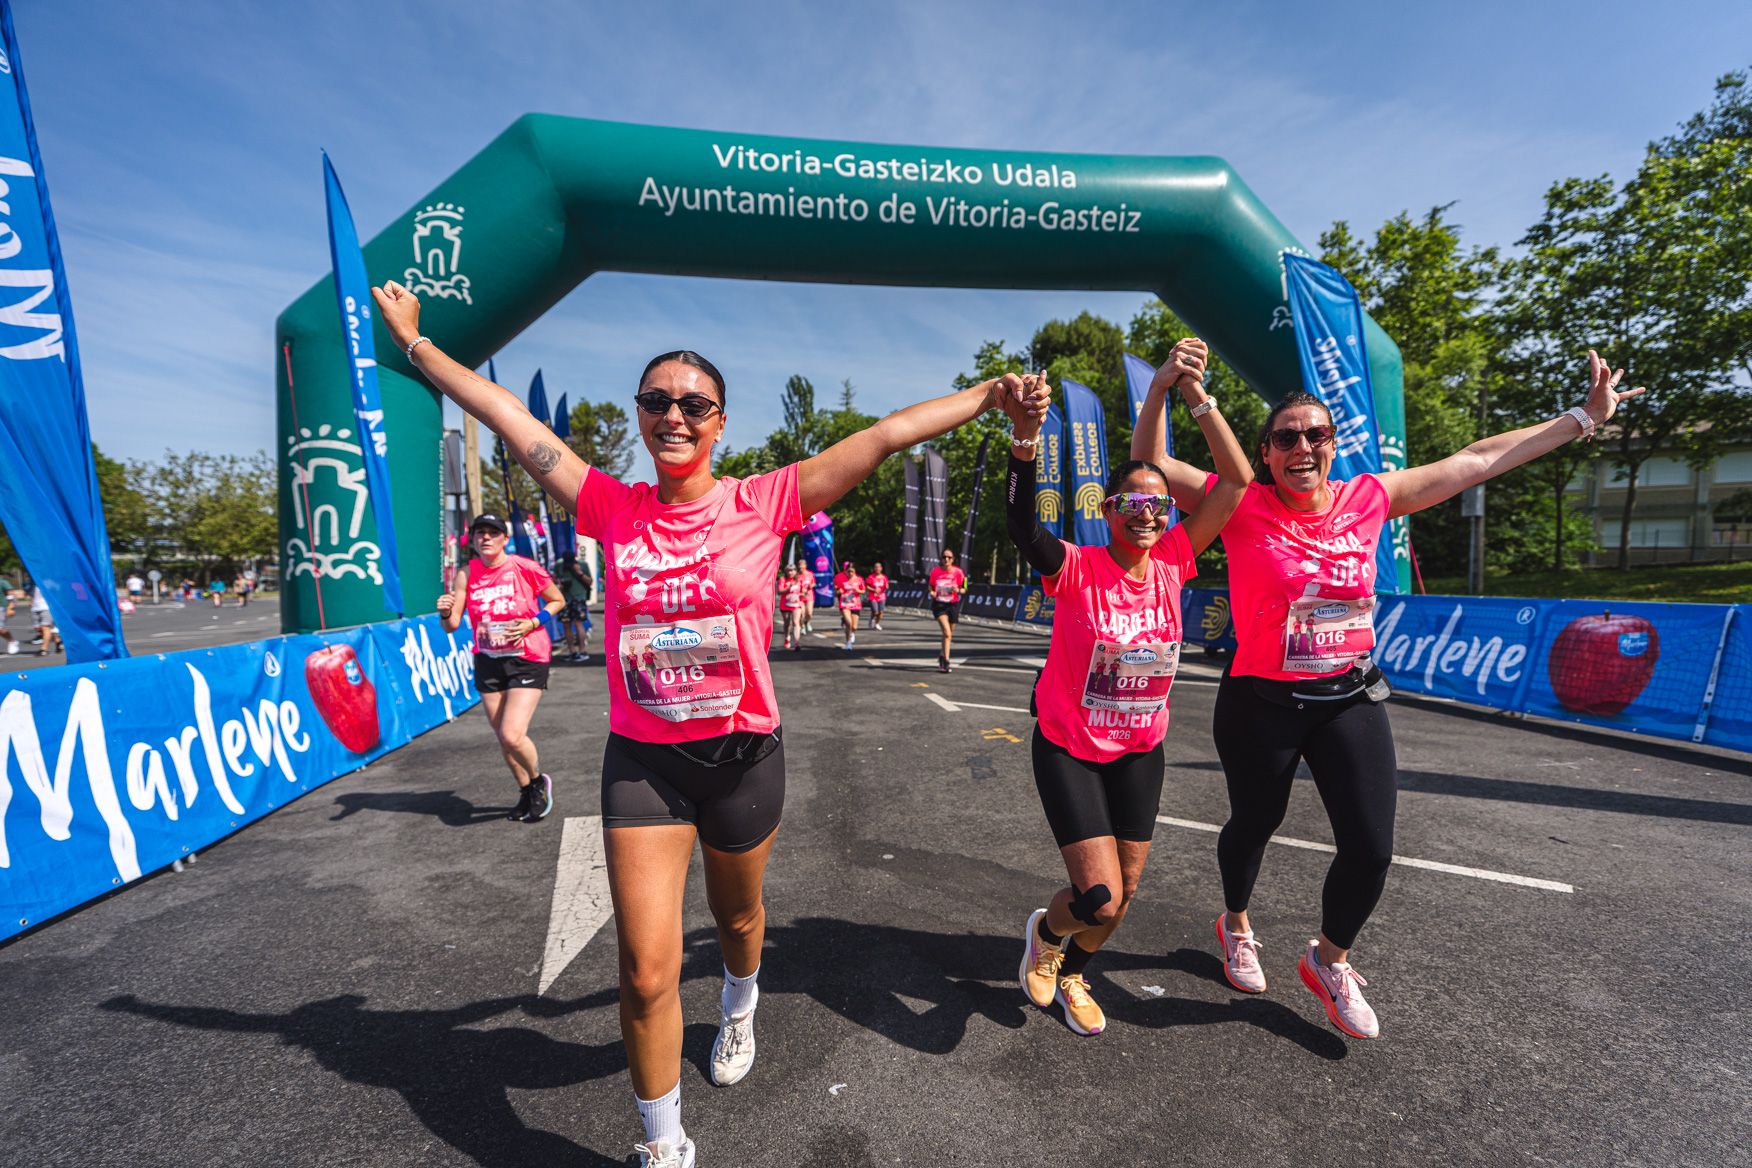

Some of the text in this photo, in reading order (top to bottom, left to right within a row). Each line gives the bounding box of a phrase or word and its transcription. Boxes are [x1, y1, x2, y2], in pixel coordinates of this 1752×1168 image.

[712, 144, 1077, 189] Vitoria-Gasteizko Udala
[638, 177, 1142, 233] Ayuntamiento de Vitoria-Gasteiz
[1008, 471, 1018, 504] KIPRUN
[968, 595, 1014, 608] VOLVO
[655, 637, 699, 647] ASTURIANA
[1316, 631, 1346, 645] 016
[1372, 601, 1527, 695] Marlene
[660, 665, 705, 685] 016
[1116, 676, 1149, 688] 016
[677, 685, 694, 693] 406
[671, 695, 691, 703] MUJER
[700, 703, 734, 712] Santander
[1088, 709, 1153, 728] MUJER
[1107, 730, 1131, 740] 2026
[0, 662, 310, 882] Marlene
